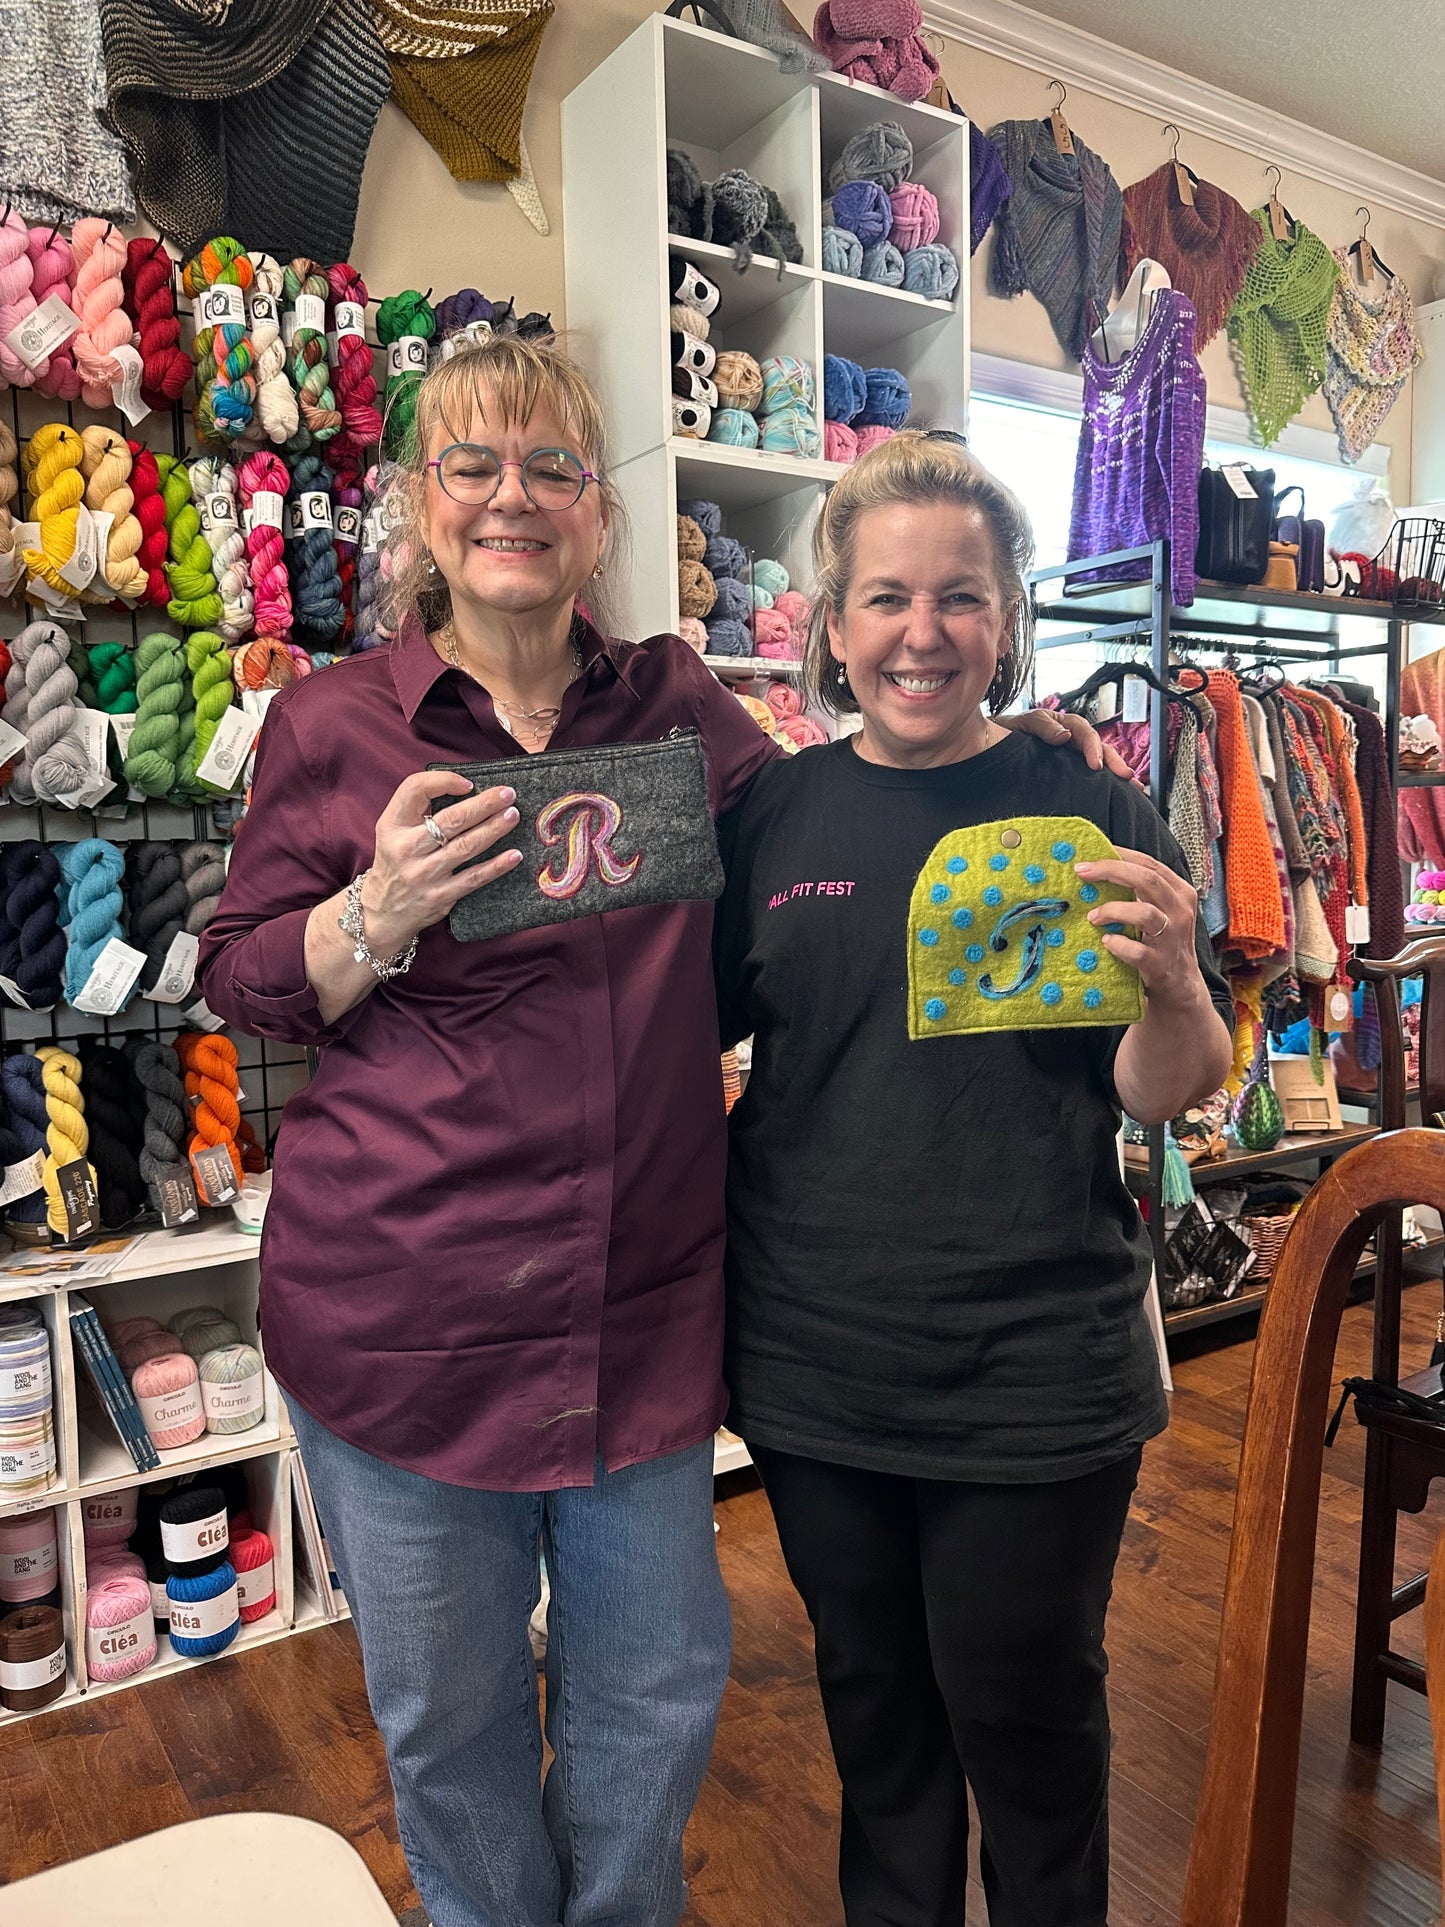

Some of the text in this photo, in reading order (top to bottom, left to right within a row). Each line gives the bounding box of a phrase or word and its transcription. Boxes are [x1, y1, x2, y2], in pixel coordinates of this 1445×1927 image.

[536, 790, 642, 900] R
[791, 883, 814, 899] FIT
[817, 881, 855, 896] FEST
[154, 1401, 197, 1421] Charme
[211, 1395, 252, 1408] Charme
[87, 1503, 123, 1519] Cléa
[197, 1525, 227, 1548] Cléa
[171, 1613, 202, 1629] Cléa
[100, 1632, 139, 1655] Cléa
